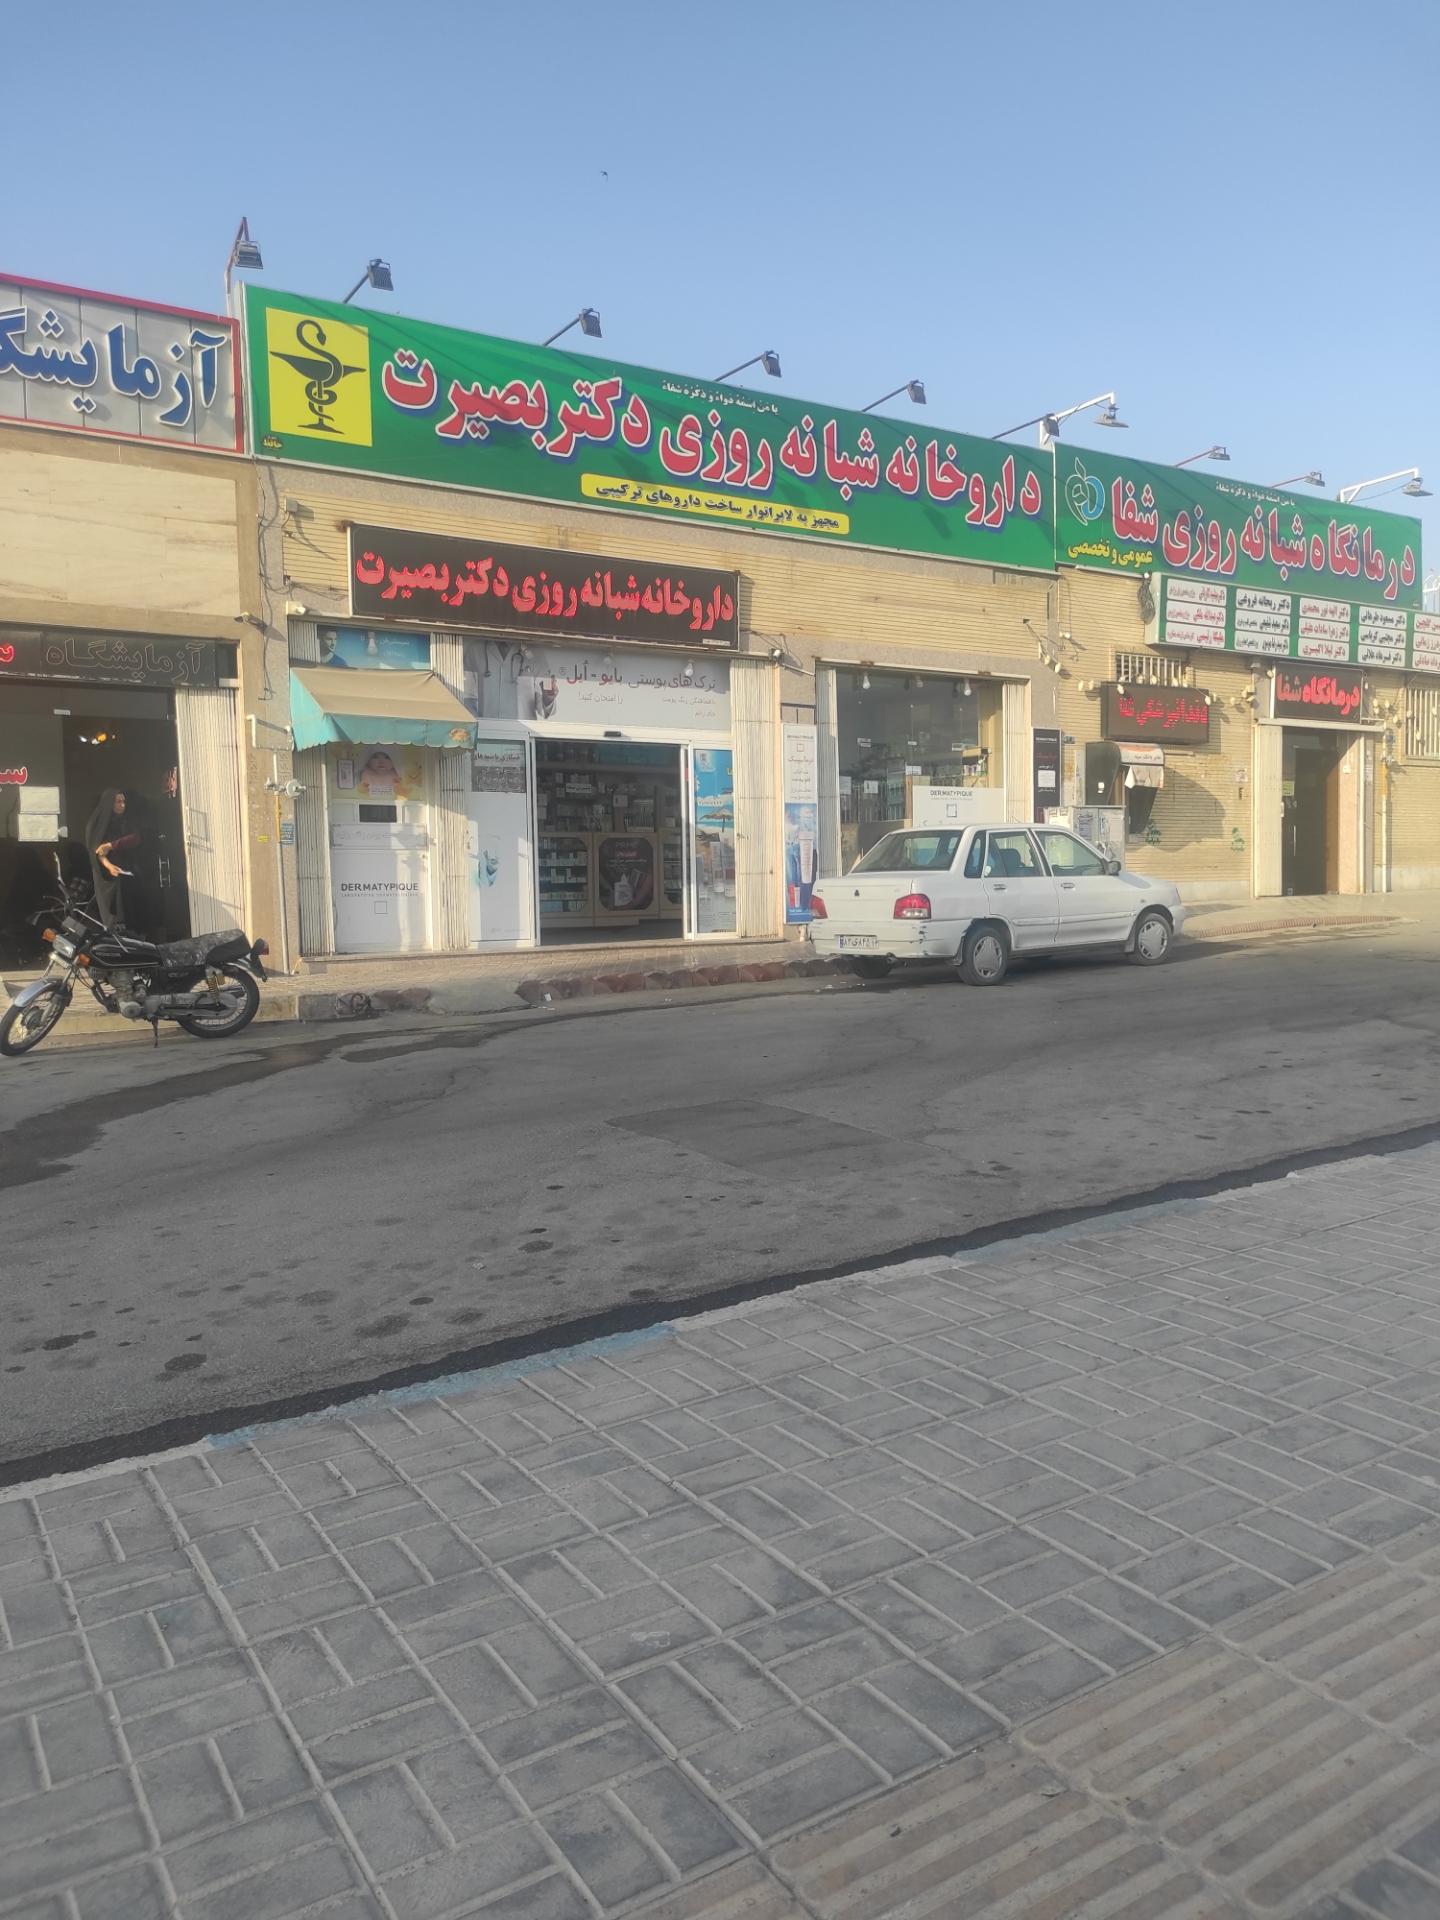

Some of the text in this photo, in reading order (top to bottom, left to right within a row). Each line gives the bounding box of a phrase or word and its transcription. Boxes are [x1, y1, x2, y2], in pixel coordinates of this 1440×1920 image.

[0, 306, 228, 428] آزمایشگ
[382, 348, 1042, 529] داروخانه شبانه روزی دکتر بصیرت
[595, 483, 840, 530] مجهز به لابراتوار ساخت داروهای ترکیبی
[1067, 538, 1110, 560] تخصصی
[1111, 476, 1416, 600] درمانگاه شبانه روزی شفا
[1117, 549, 1152, 568] عمومی
[355, 551, 734, 631] داروخانه شبانه روزی دکتر بصیرت
[46, 637, 207, 684] آزمایشگاه
[598, 667, 623, 686] بایو
[628, 673, 667, 690] پوستی
[668, 672, 692, 689] های
[694, 674, 716, 692] ترک
[1276, 673, 1360, 716] درمانگاه شفا
[930, 789, 973, 797] DERMATYPIQUE
[340, 882, 419, 892] DERMATYPIQUE
